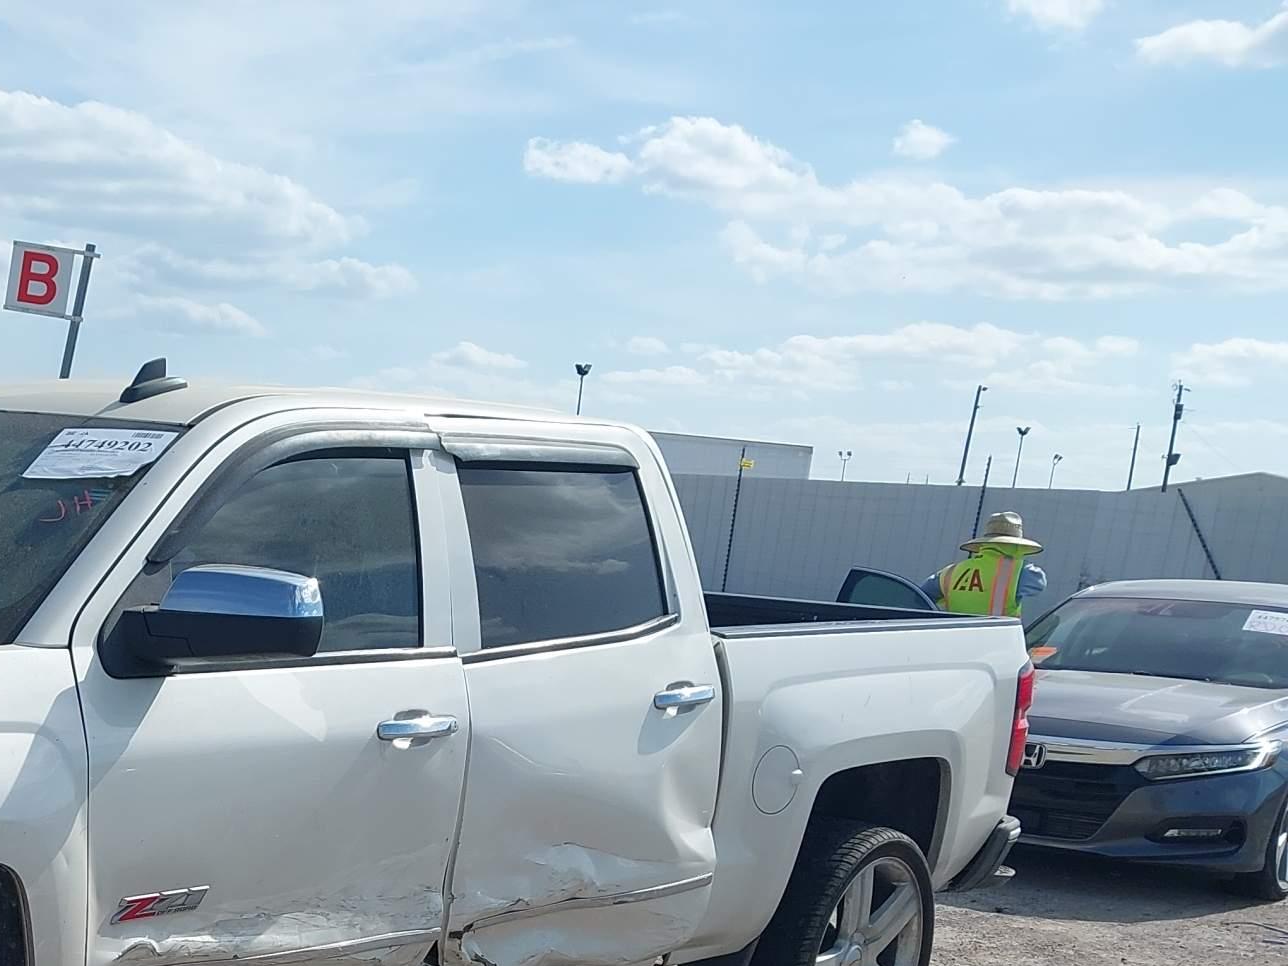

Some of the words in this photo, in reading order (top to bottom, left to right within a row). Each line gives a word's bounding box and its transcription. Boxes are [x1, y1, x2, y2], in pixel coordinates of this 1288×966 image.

[17, 251, 59, 305] B
[62, 438, 153, 452] 44749202
[111, 885, 211, 924] Z71
